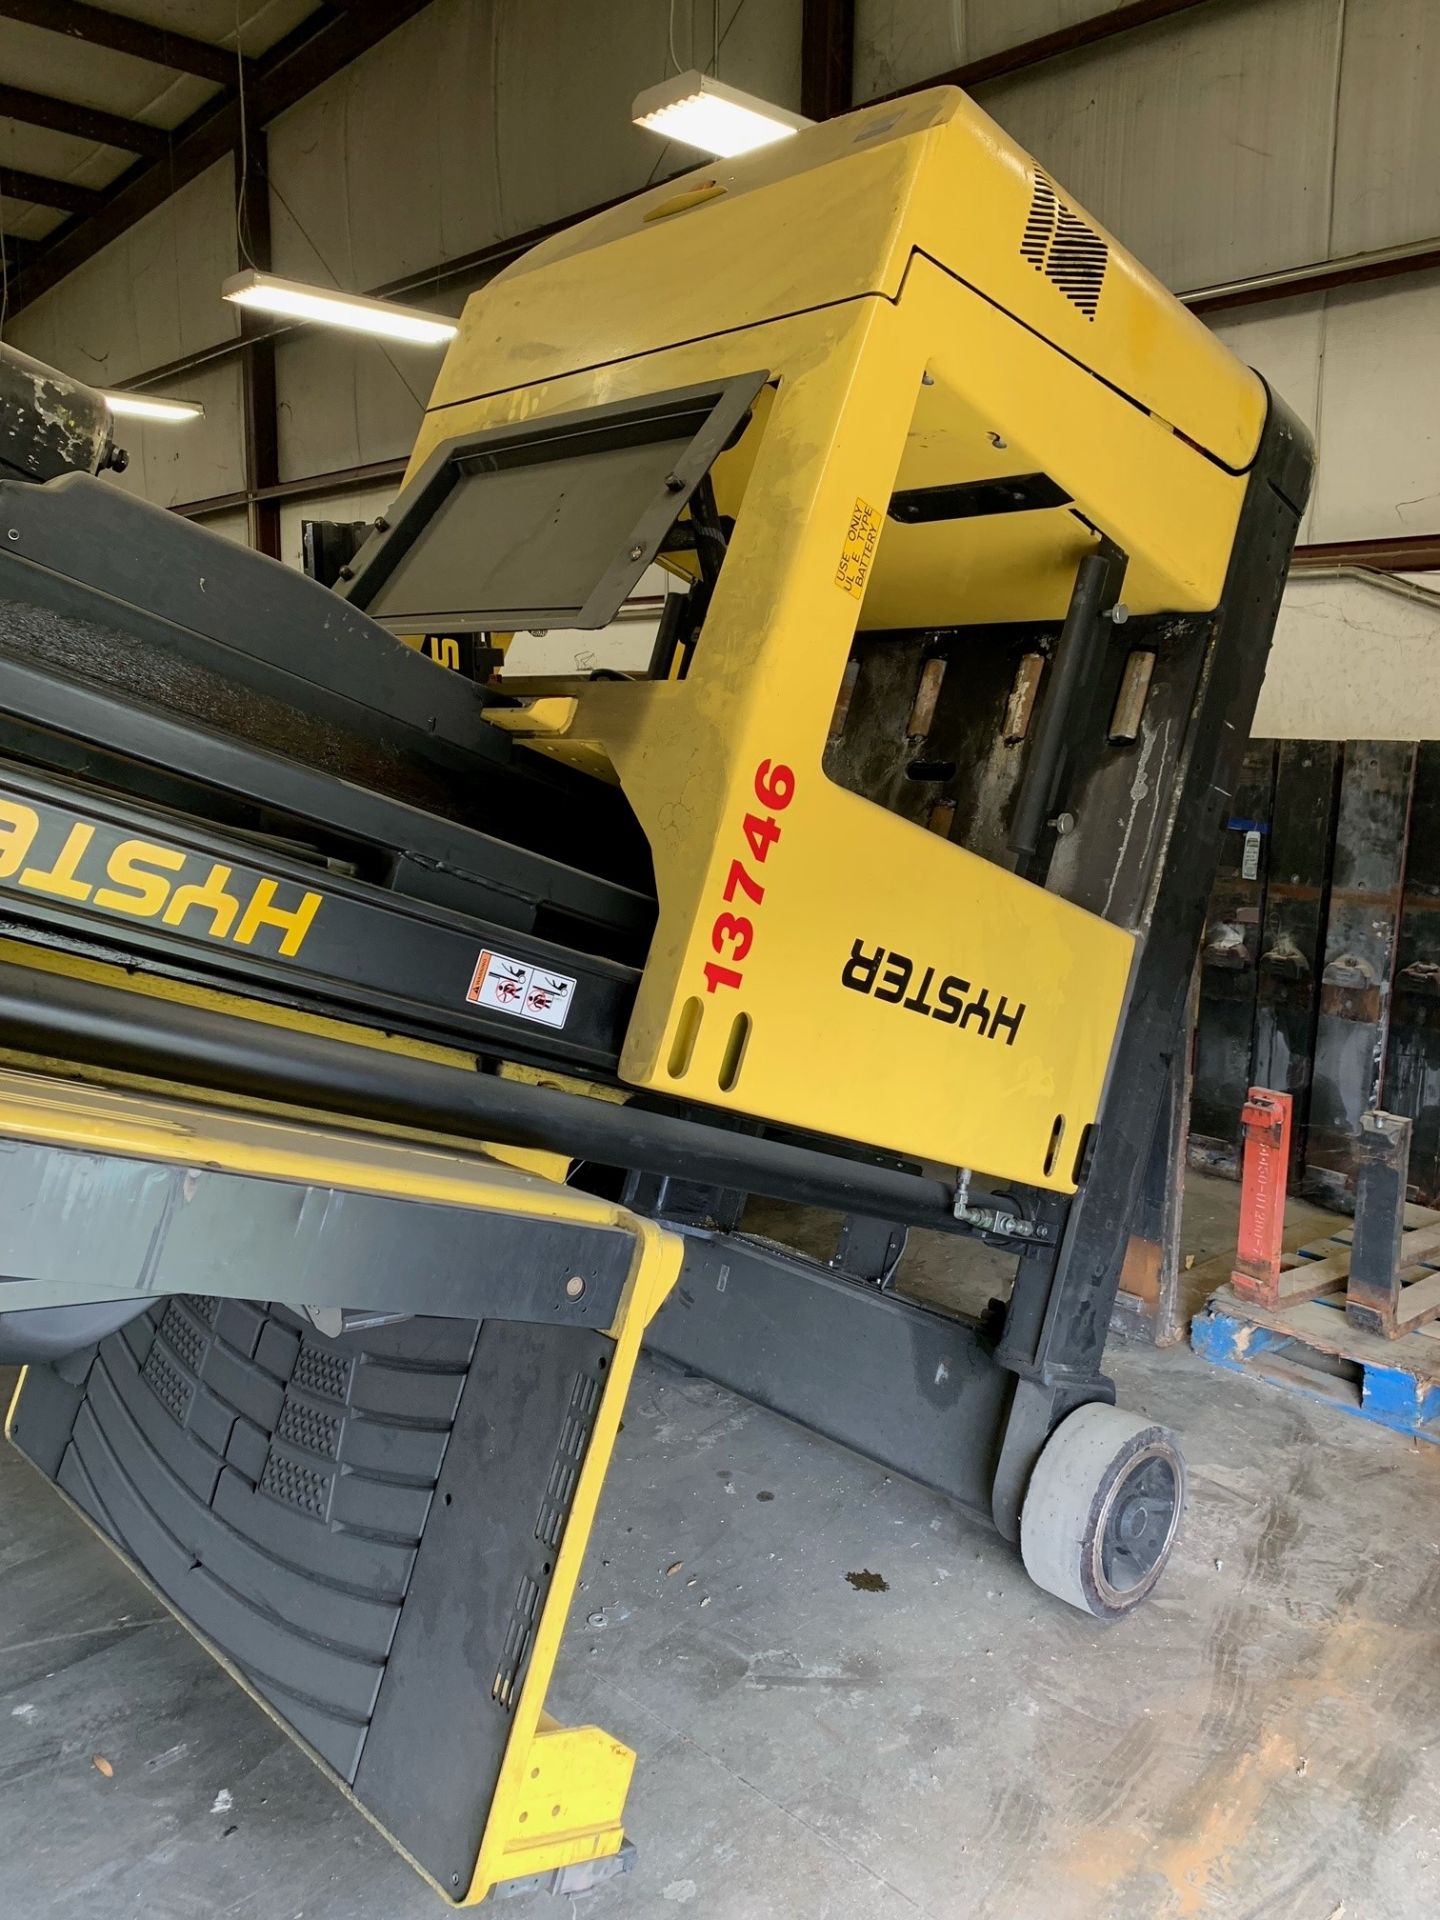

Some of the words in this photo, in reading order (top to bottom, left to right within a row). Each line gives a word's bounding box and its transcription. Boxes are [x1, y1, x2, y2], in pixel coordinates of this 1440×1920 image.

[836, 552, 851, 582] USE
[847, 504, 863, 542] ONLY
[844, 576, 855, 592] UL
[851, 551, 861, 563] E
[857, 505, 873, 542] TYPE
[854, 523, 877, 588] BATTERY
[703, 758, 796, 994] 13746
[841, 937, 1027, 1046] HYSTER
